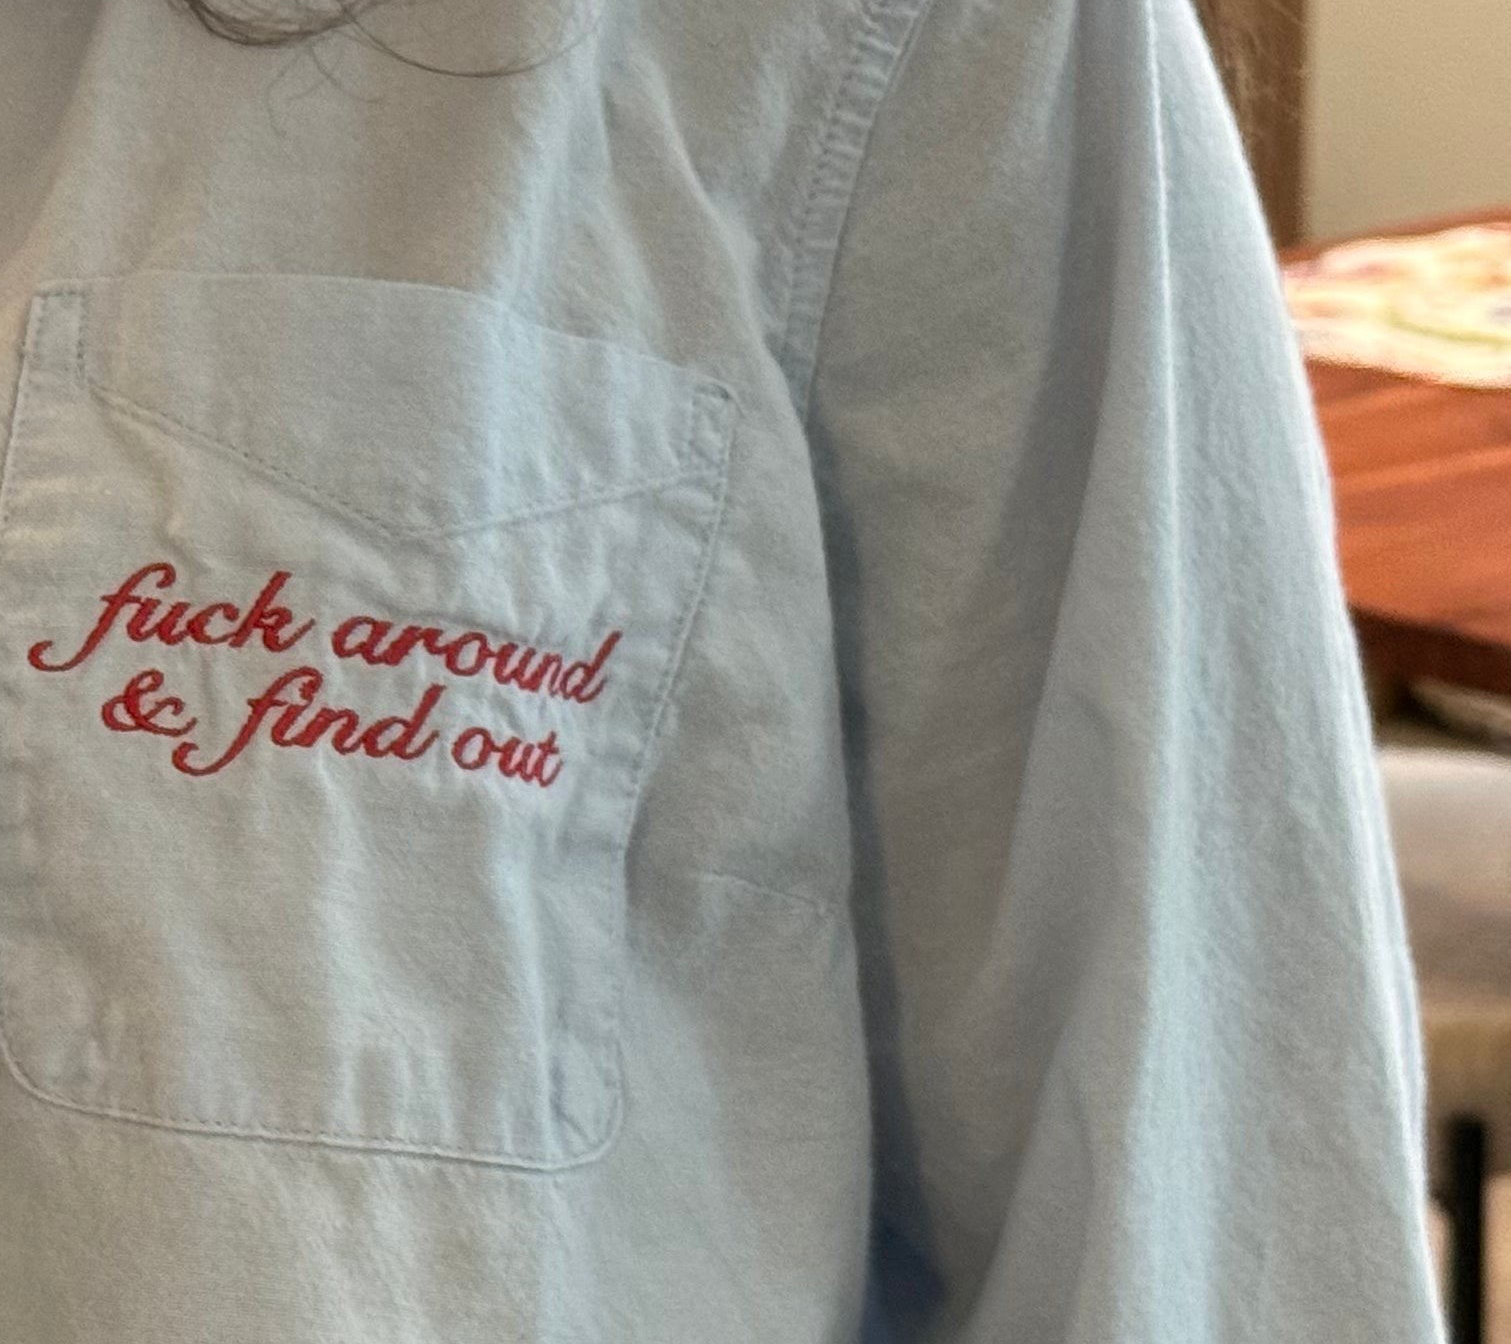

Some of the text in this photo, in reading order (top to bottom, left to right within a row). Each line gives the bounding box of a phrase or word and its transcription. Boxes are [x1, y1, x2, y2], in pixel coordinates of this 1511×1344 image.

[28, 562, 622, 704] fuck around
[101, 666, 564, 788] & find out
